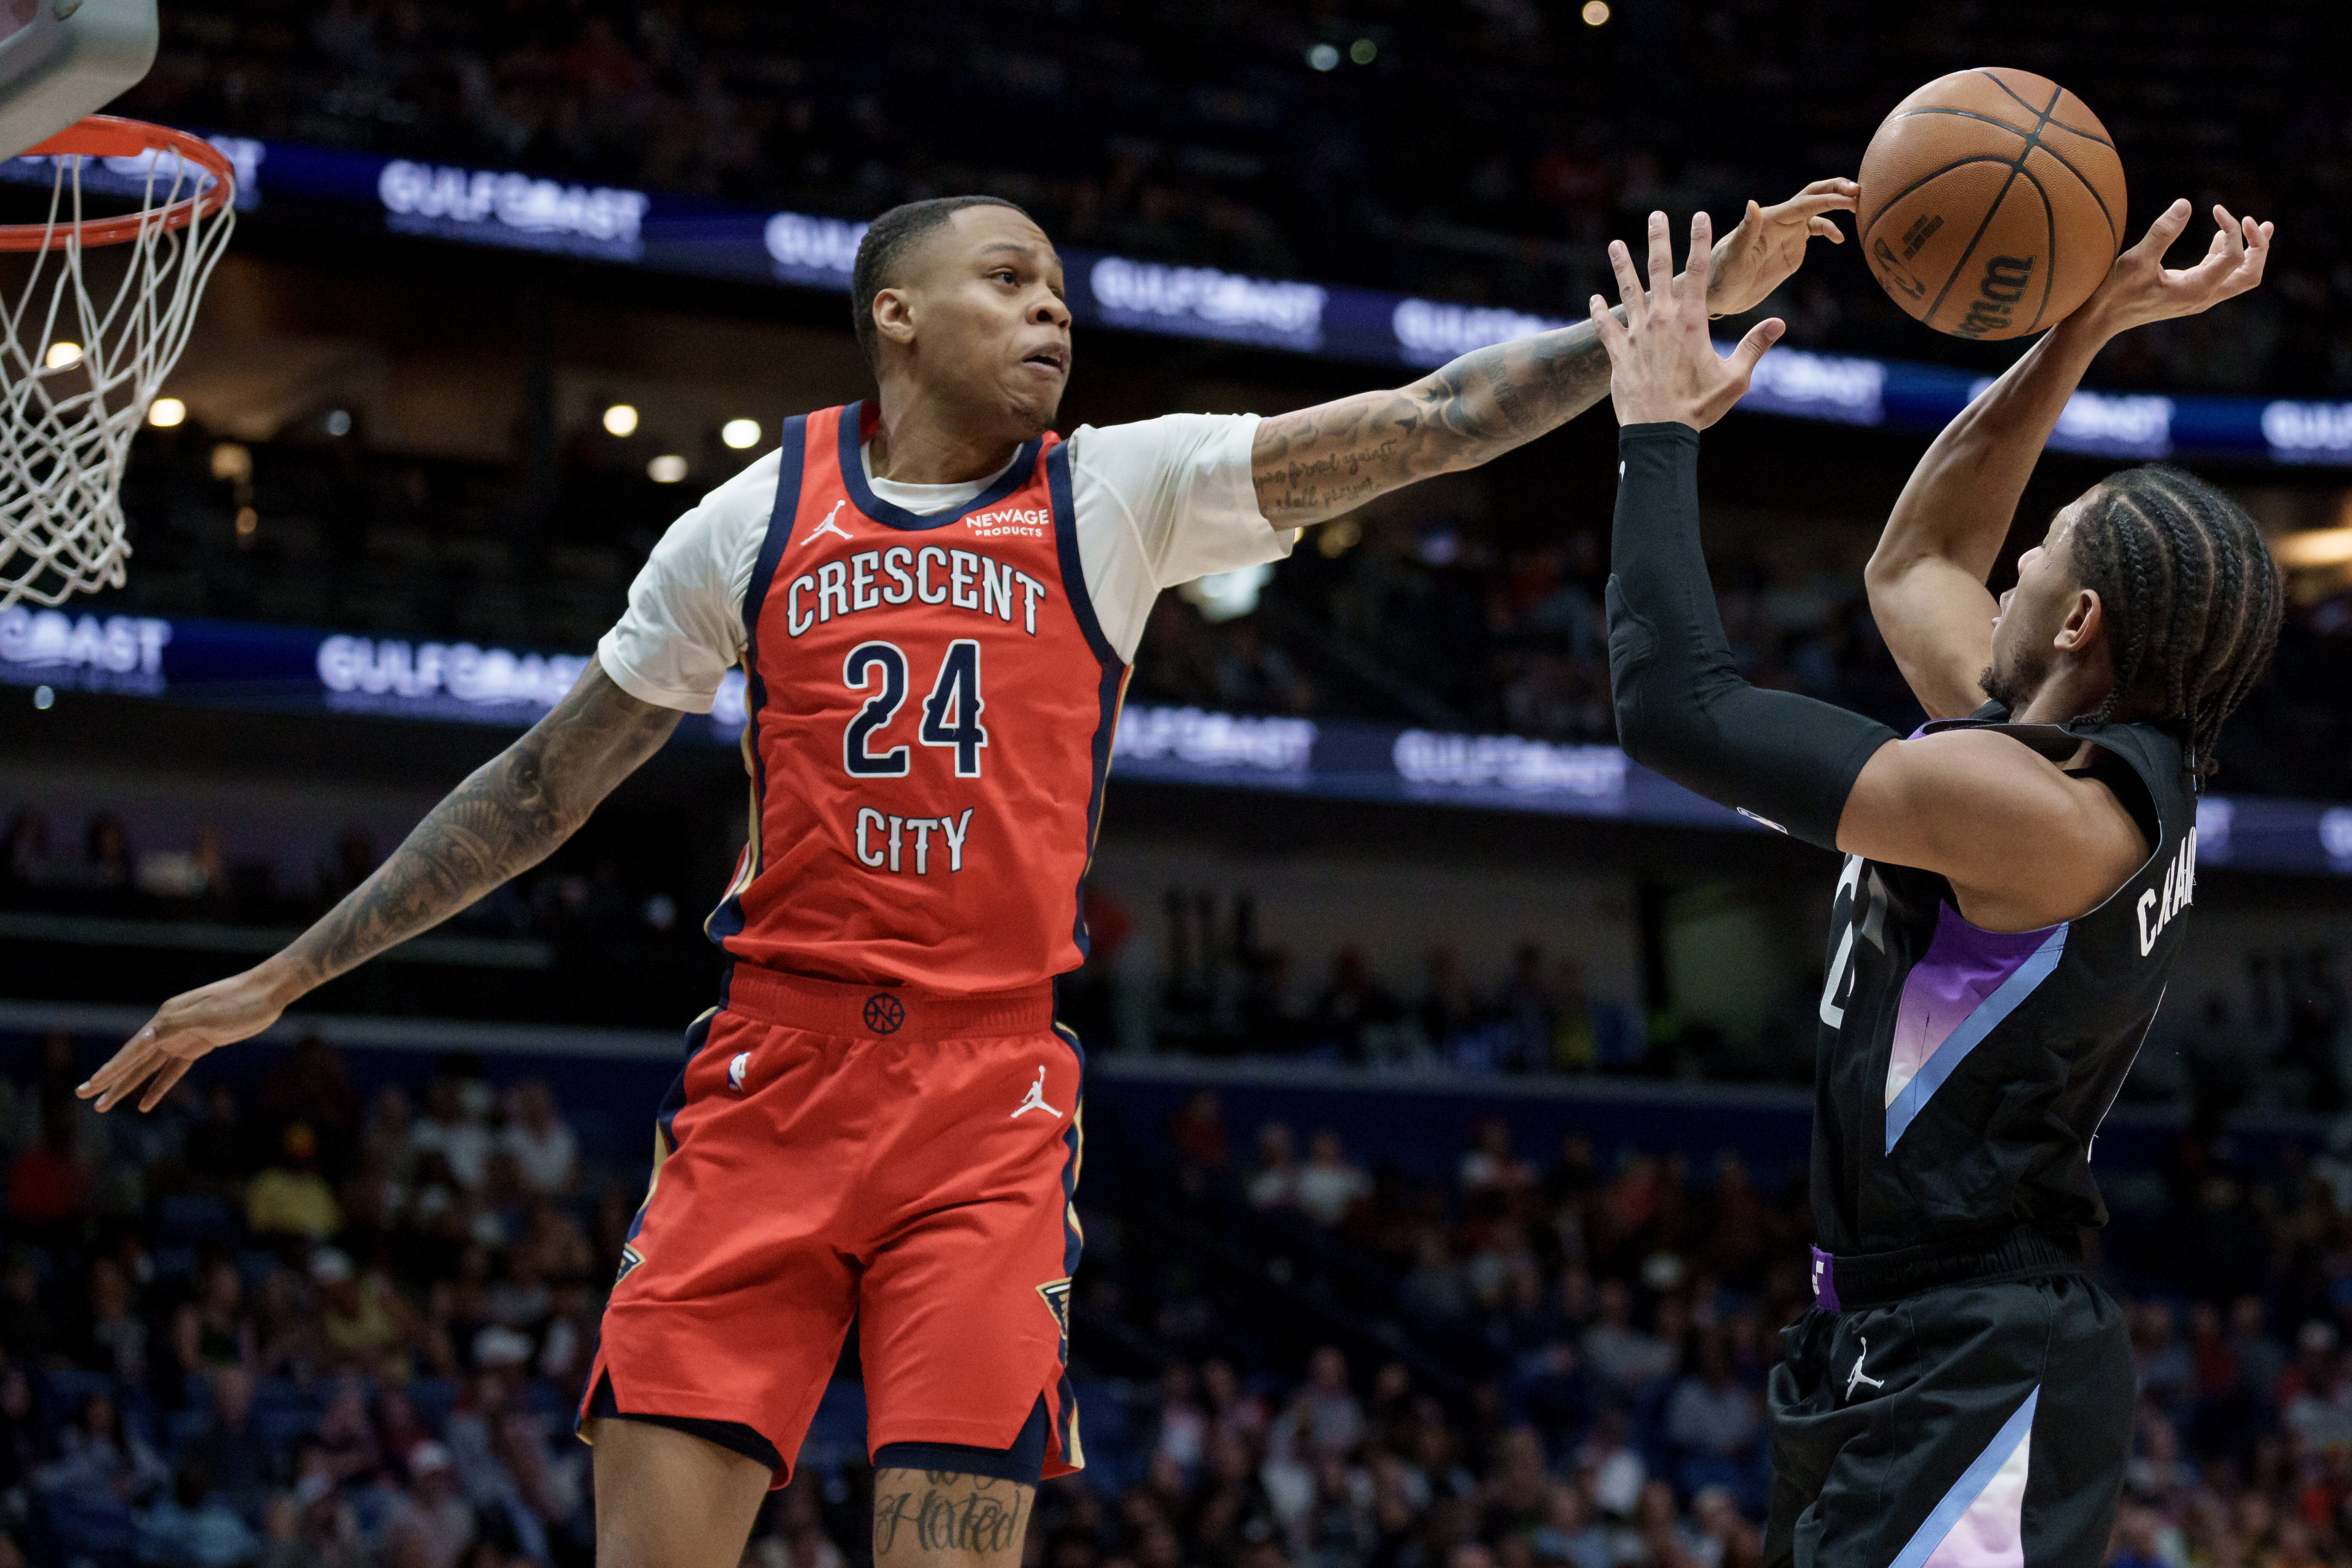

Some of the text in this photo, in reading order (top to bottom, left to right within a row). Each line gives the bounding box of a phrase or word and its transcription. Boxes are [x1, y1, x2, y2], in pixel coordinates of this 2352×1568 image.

[966, 509, 1049, 528] NEWAGE
[975, 526, 1043, 537] PRODUCTS
[787, 546, 1046, 638] CRESCENT
[843, 639, 988, 778] 24
[854, 806, 974, 875] CITY
